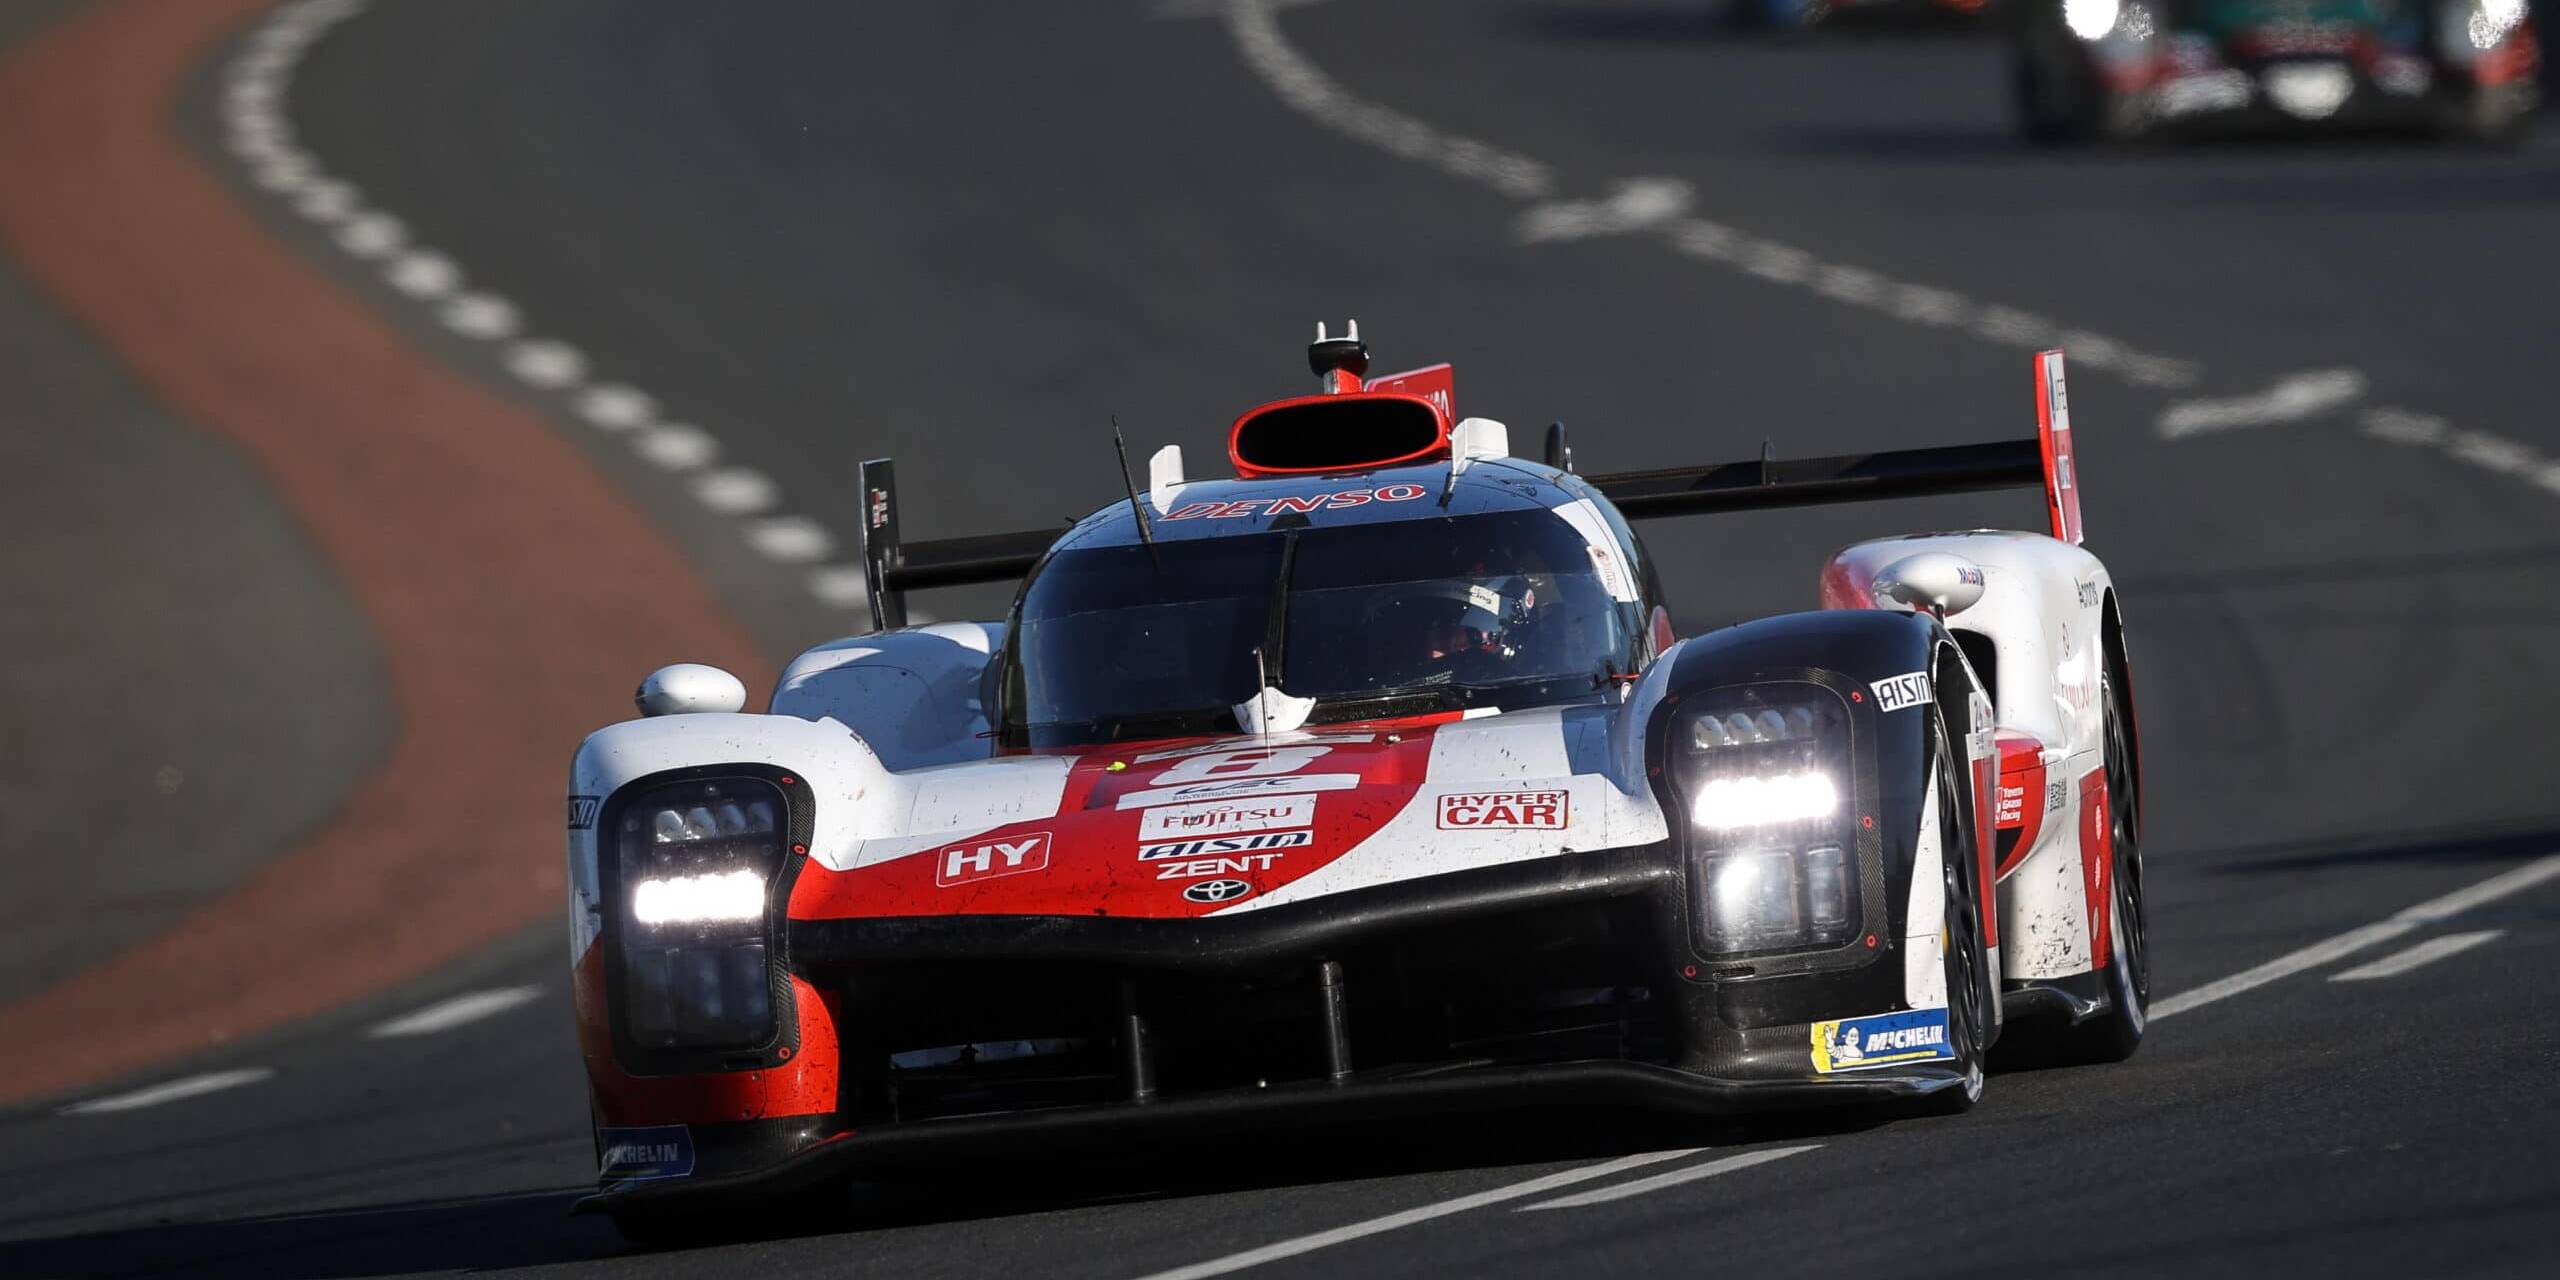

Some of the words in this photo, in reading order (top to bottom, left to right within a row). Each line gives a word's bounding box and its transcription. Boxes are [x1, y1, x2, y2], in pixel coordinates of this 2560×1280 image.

[1158, 484, 1426, 522] DENSO
[1879, 674, 1932, 709] AISIN
[1149, 746, 1333, 785] 8
[1447, 793, 1558, 807] HYPER
[1163, 806, 1292, 828] FUJITSU
[1446, 805, 1557, 826] CAR
[946, 838, 1041, 877] HY
[1143, 832, 1308, 859] AISIN
[1156, 853, 1283, 880] ZENT
[1865, 1025, 1944, 1052] MICHELIN
